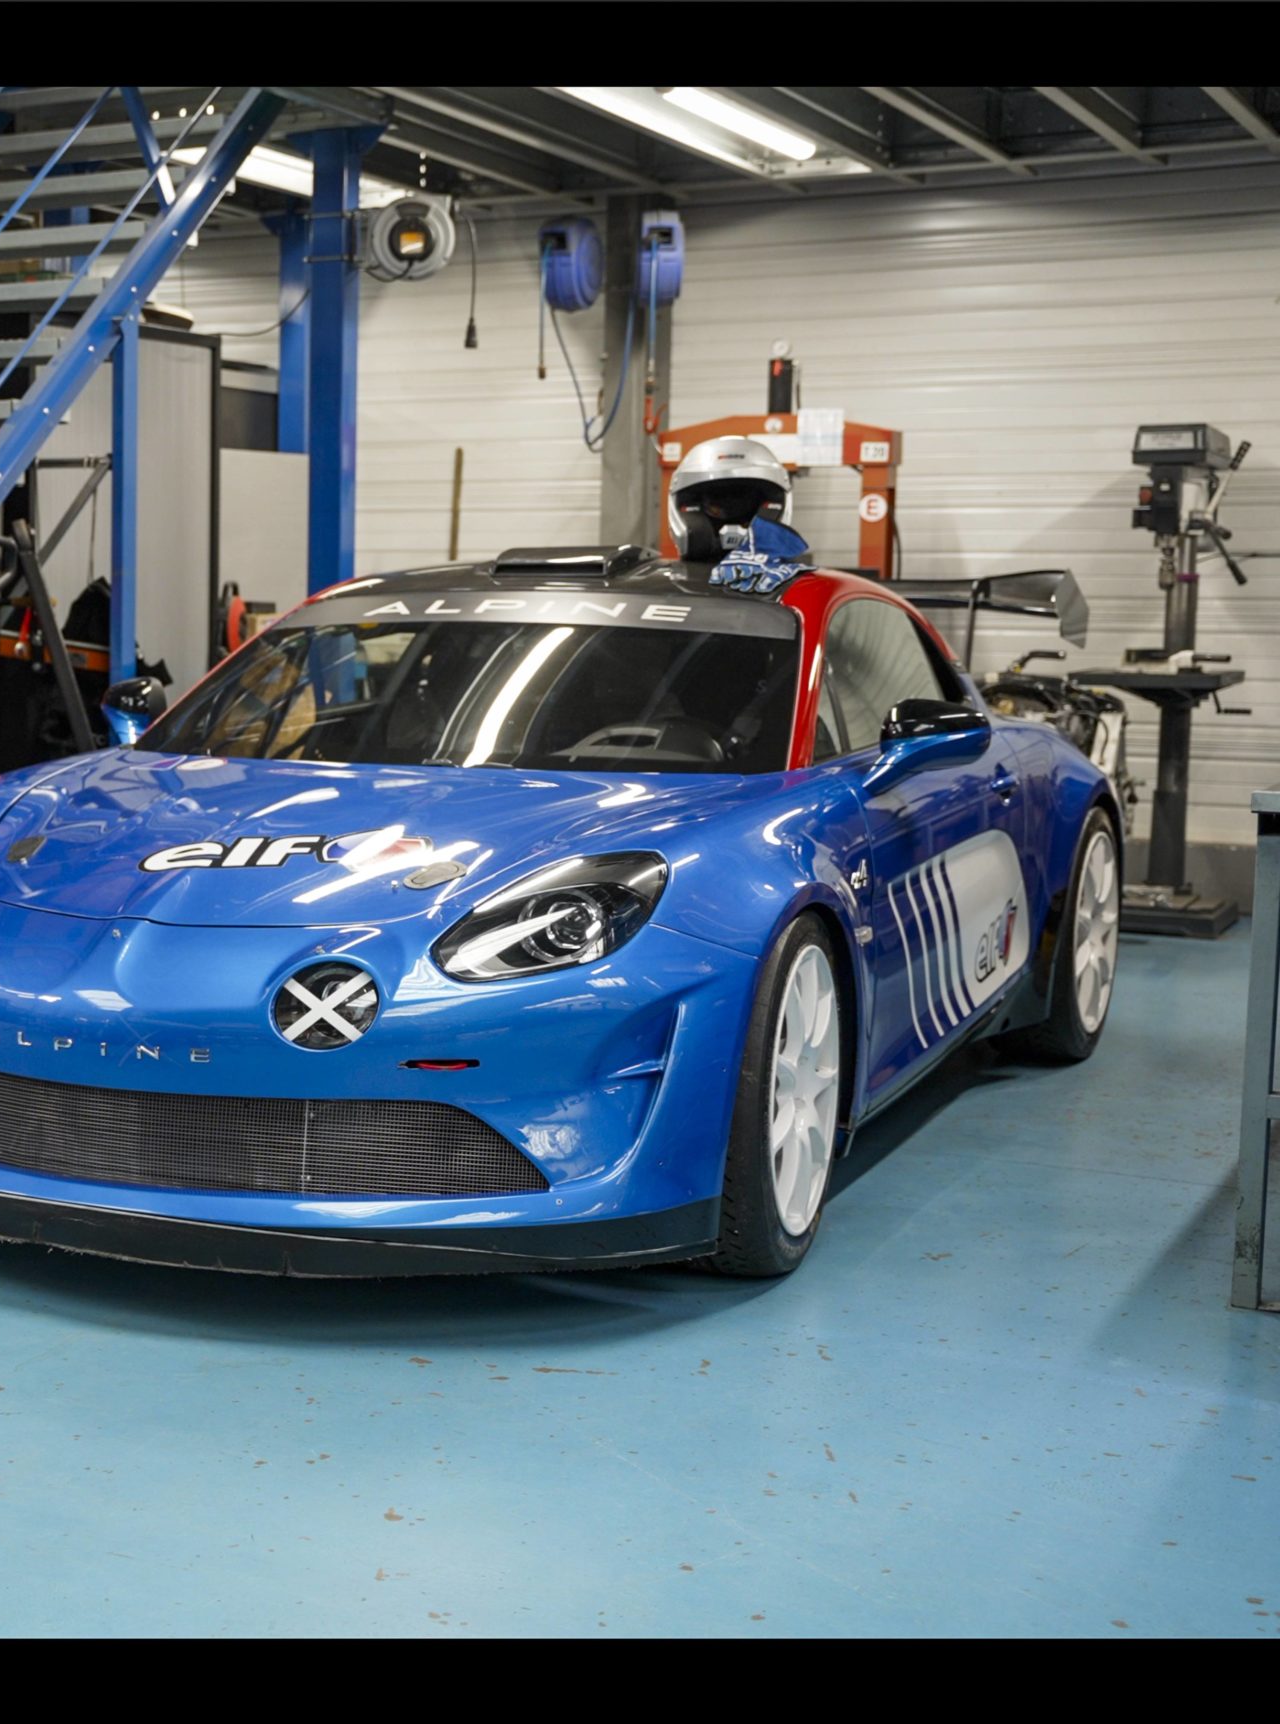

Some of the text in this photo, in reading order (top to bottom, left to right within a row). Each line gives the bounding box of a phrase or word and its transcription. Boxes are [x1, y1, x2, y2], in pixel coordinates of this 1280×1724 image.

[866, 498, 879, 516] E
[363, 599, 692, 623] ALPINE
[138, 834, 326, 872] elf
